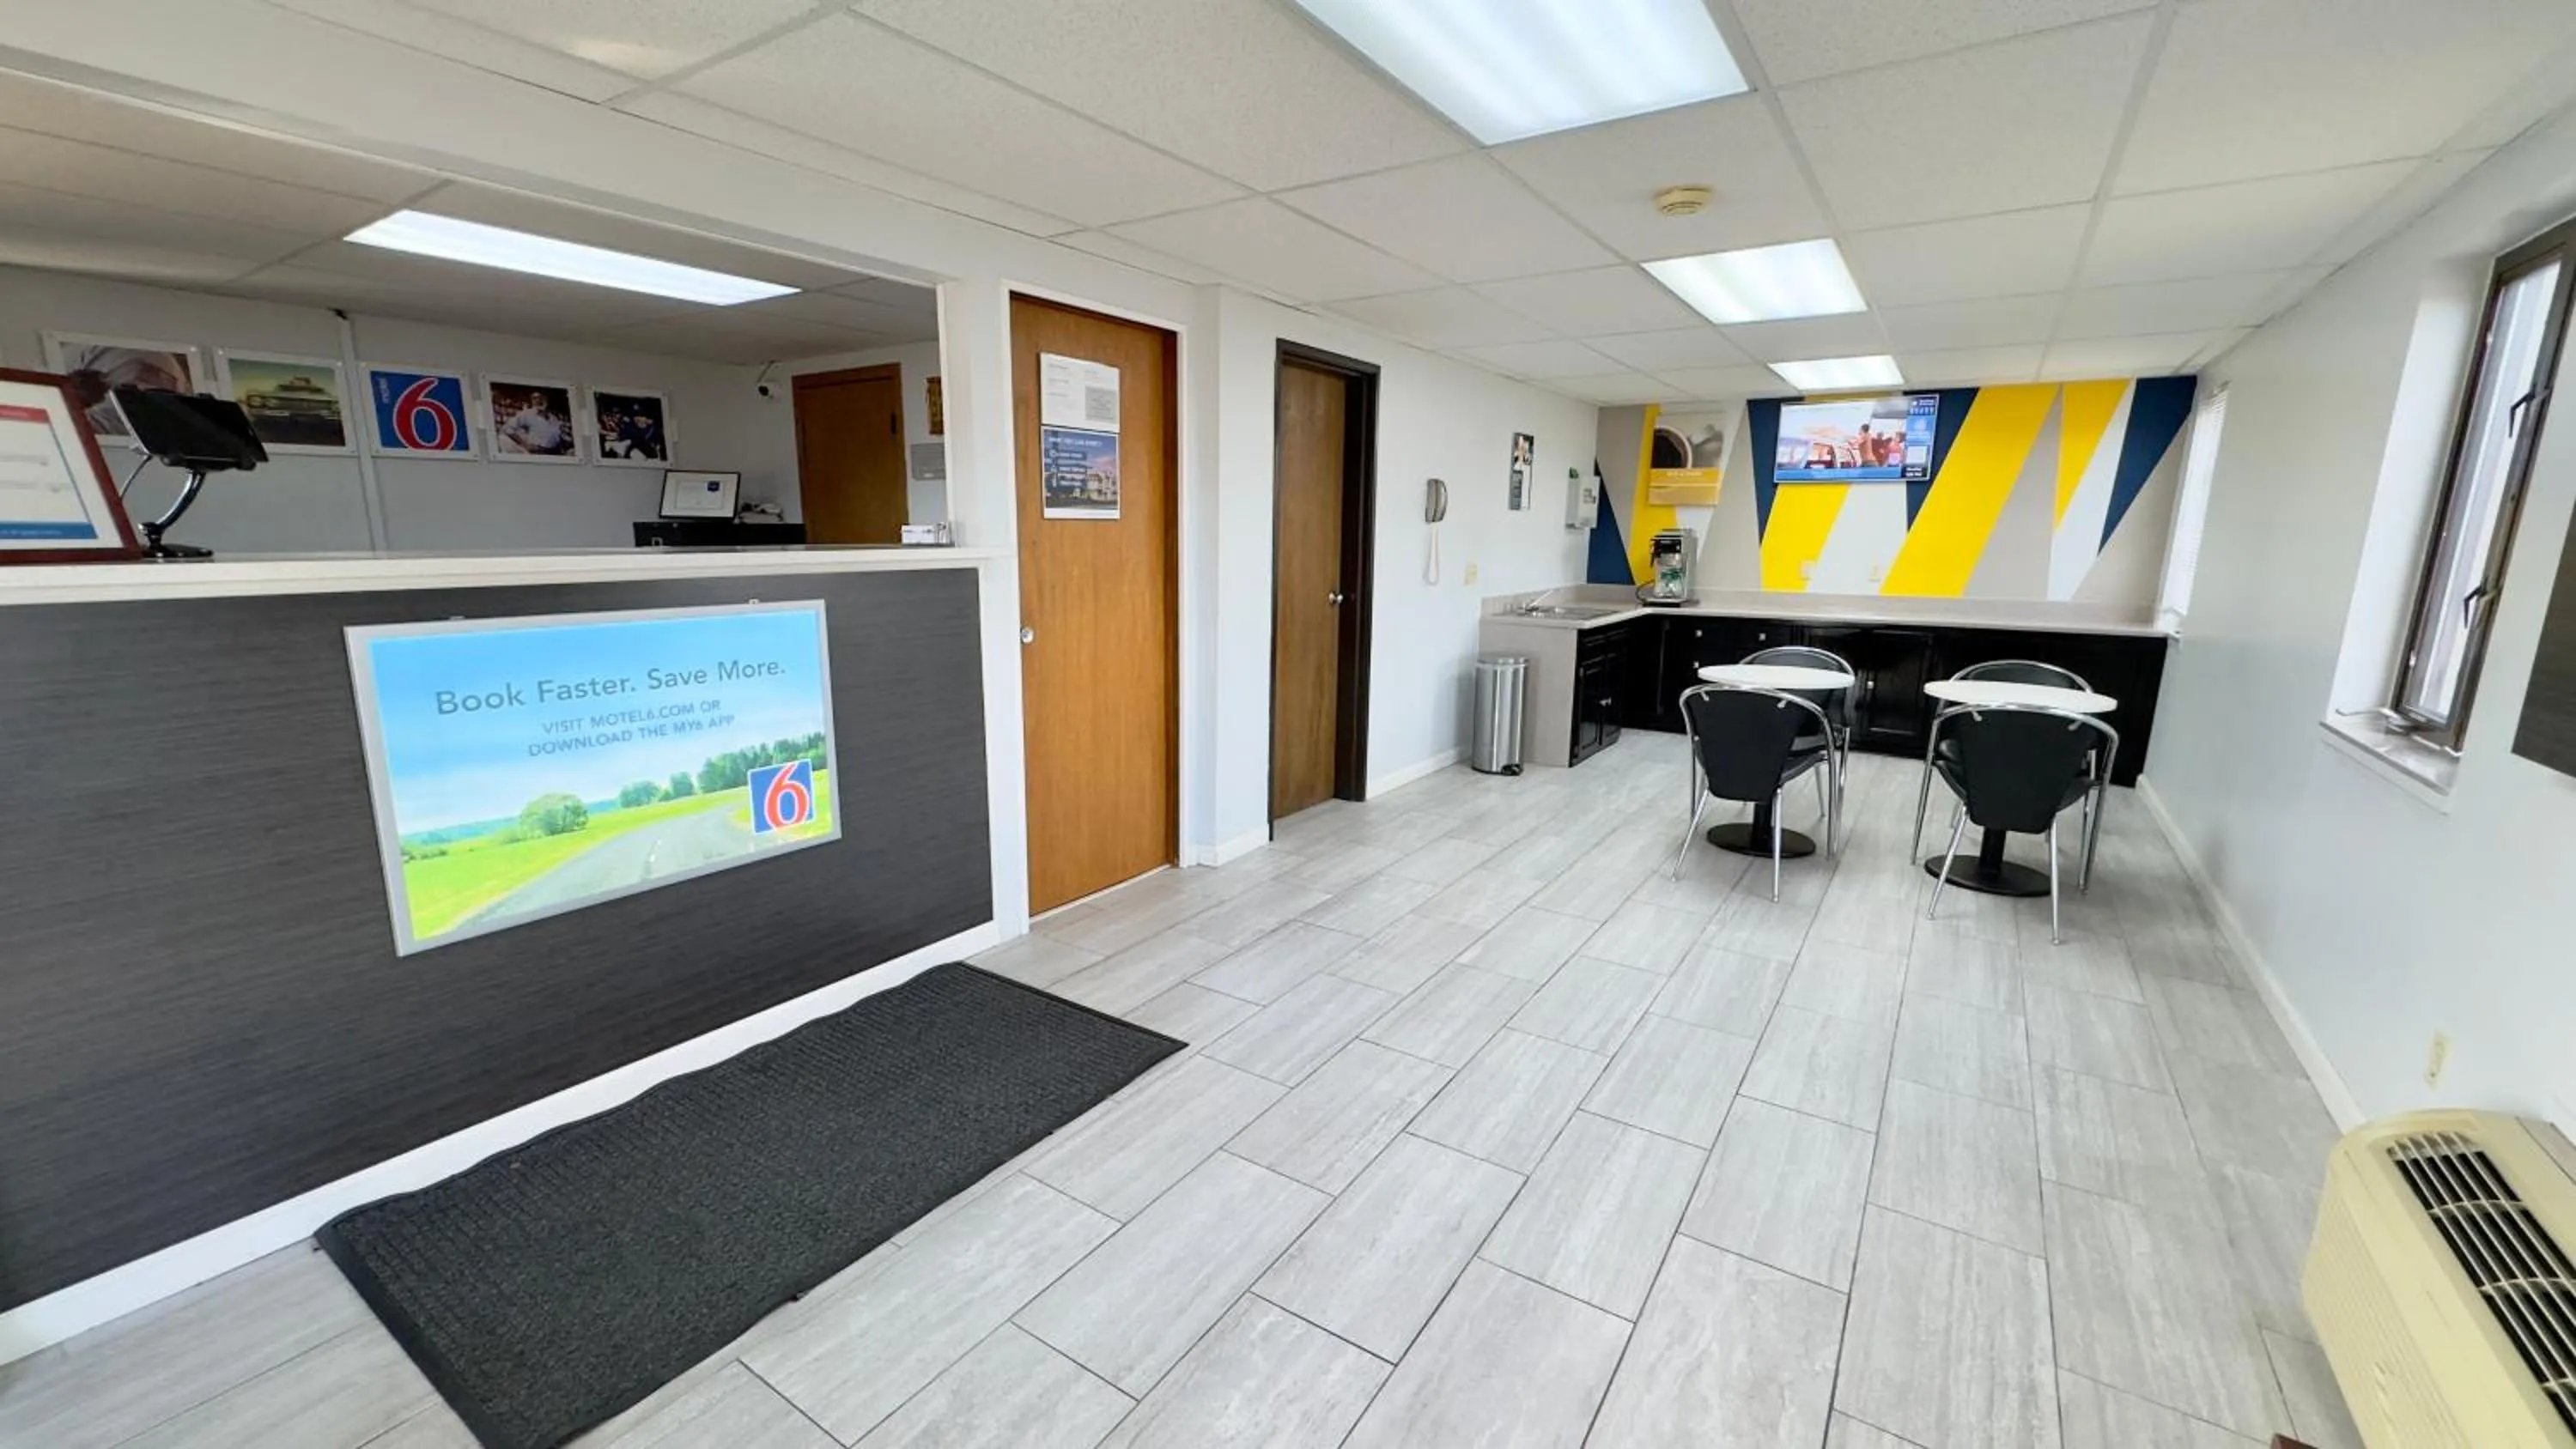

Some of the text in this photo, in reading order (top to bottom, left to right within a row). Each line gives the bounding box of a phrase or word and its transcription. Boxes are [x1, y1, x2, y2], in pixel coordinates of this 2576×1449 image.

[392, 376, 458, 452] 6
[435, 659, 786, 715] Book Faster. Save More.
[529, 714, 735, 756] DOWNLOAD THE MY6 APP
[542, 700, 721, 735] VISIT MOTEL6.COM OR
[763, 761, 811, 831] 6
